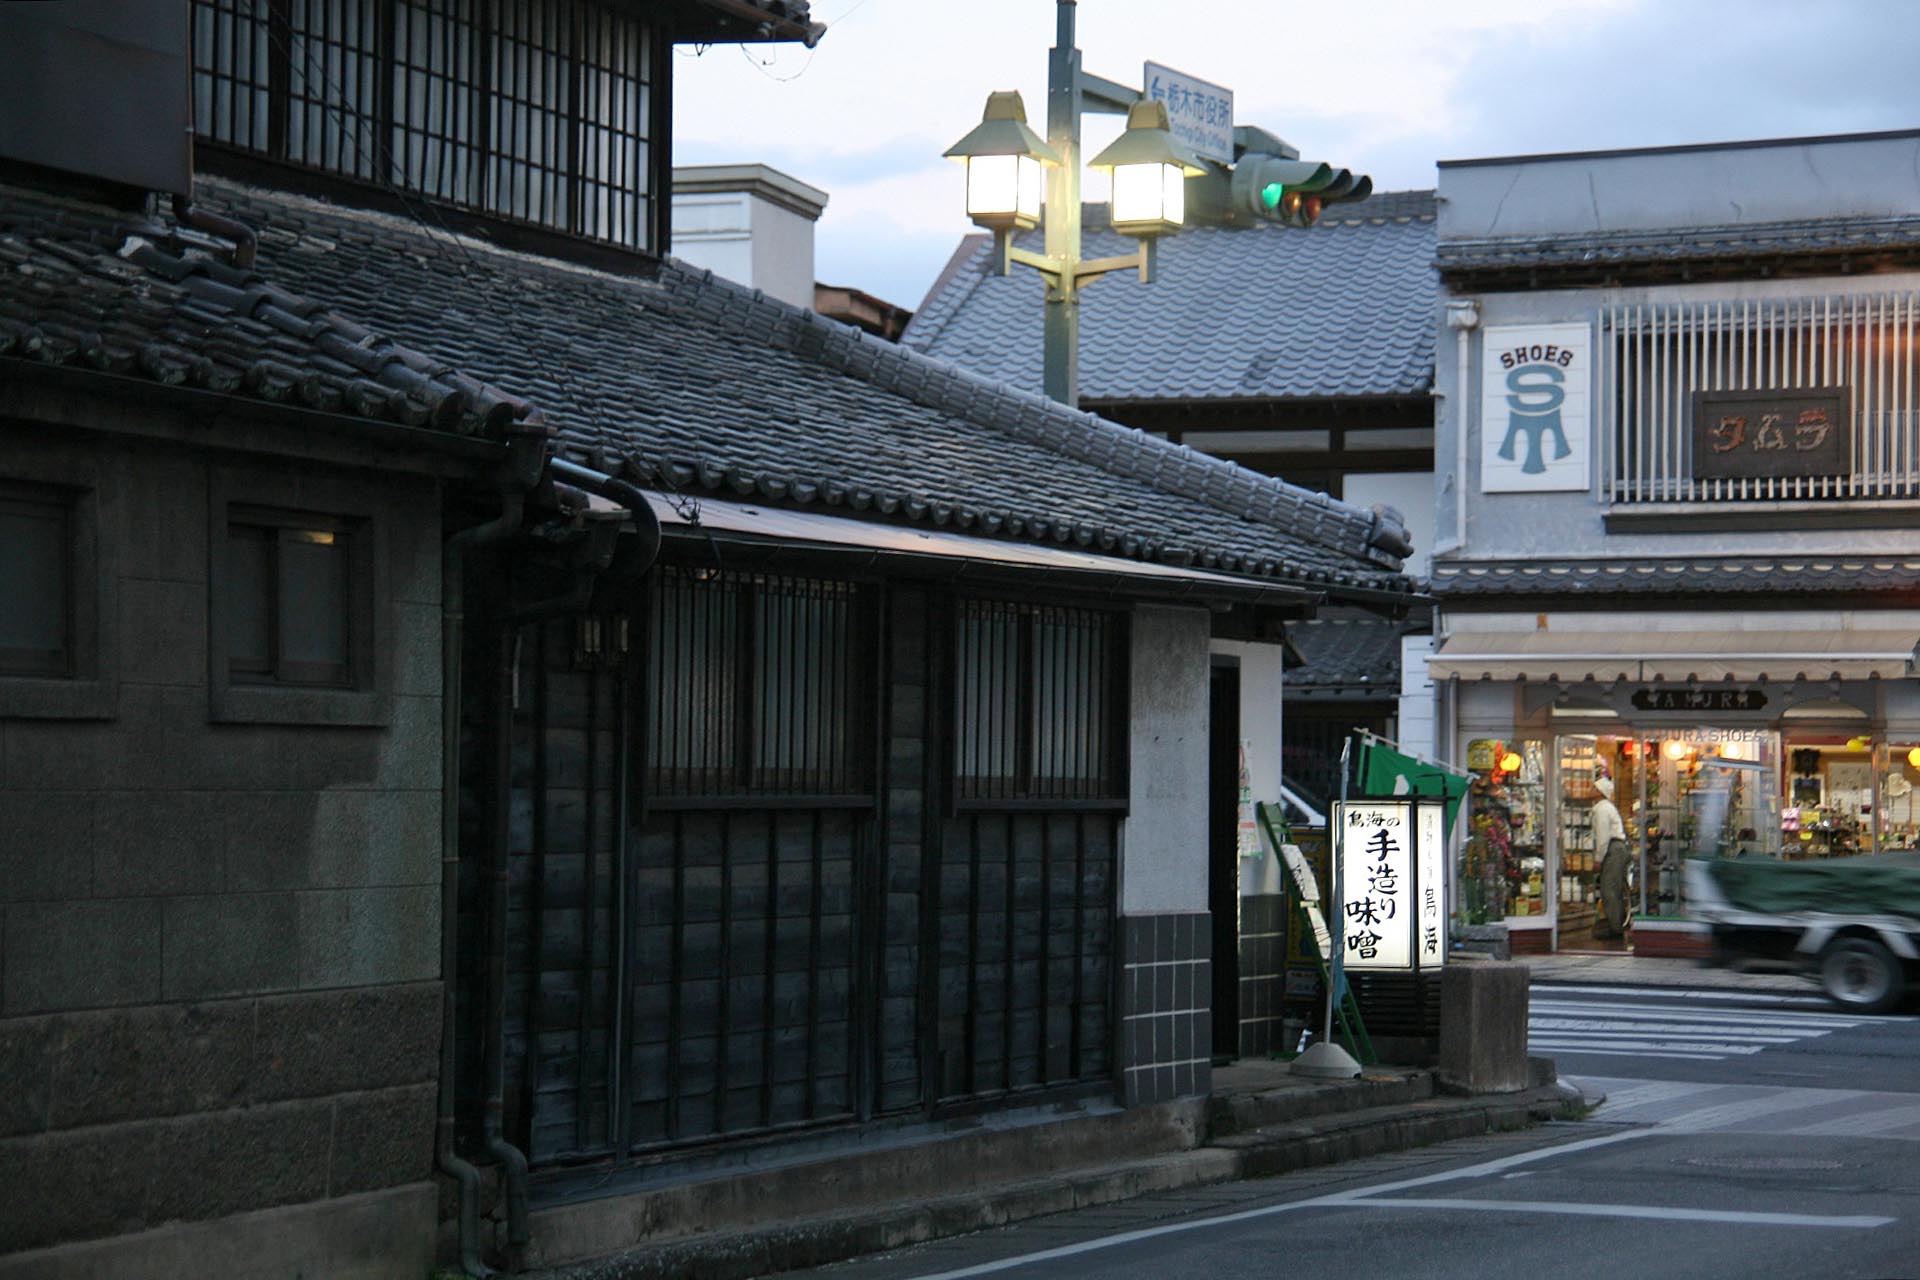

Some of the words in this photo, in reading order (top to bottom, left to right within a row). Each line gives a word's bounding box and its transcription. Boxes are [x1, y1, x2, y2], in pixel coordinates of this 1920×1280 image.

[1500, 345, 1573, 369] SHOES
[1708, 408, 1834, 453] タムラ
[1365, 829, 1400, 919] 手造り
[1344, 896, 1382, 960] 味噌
